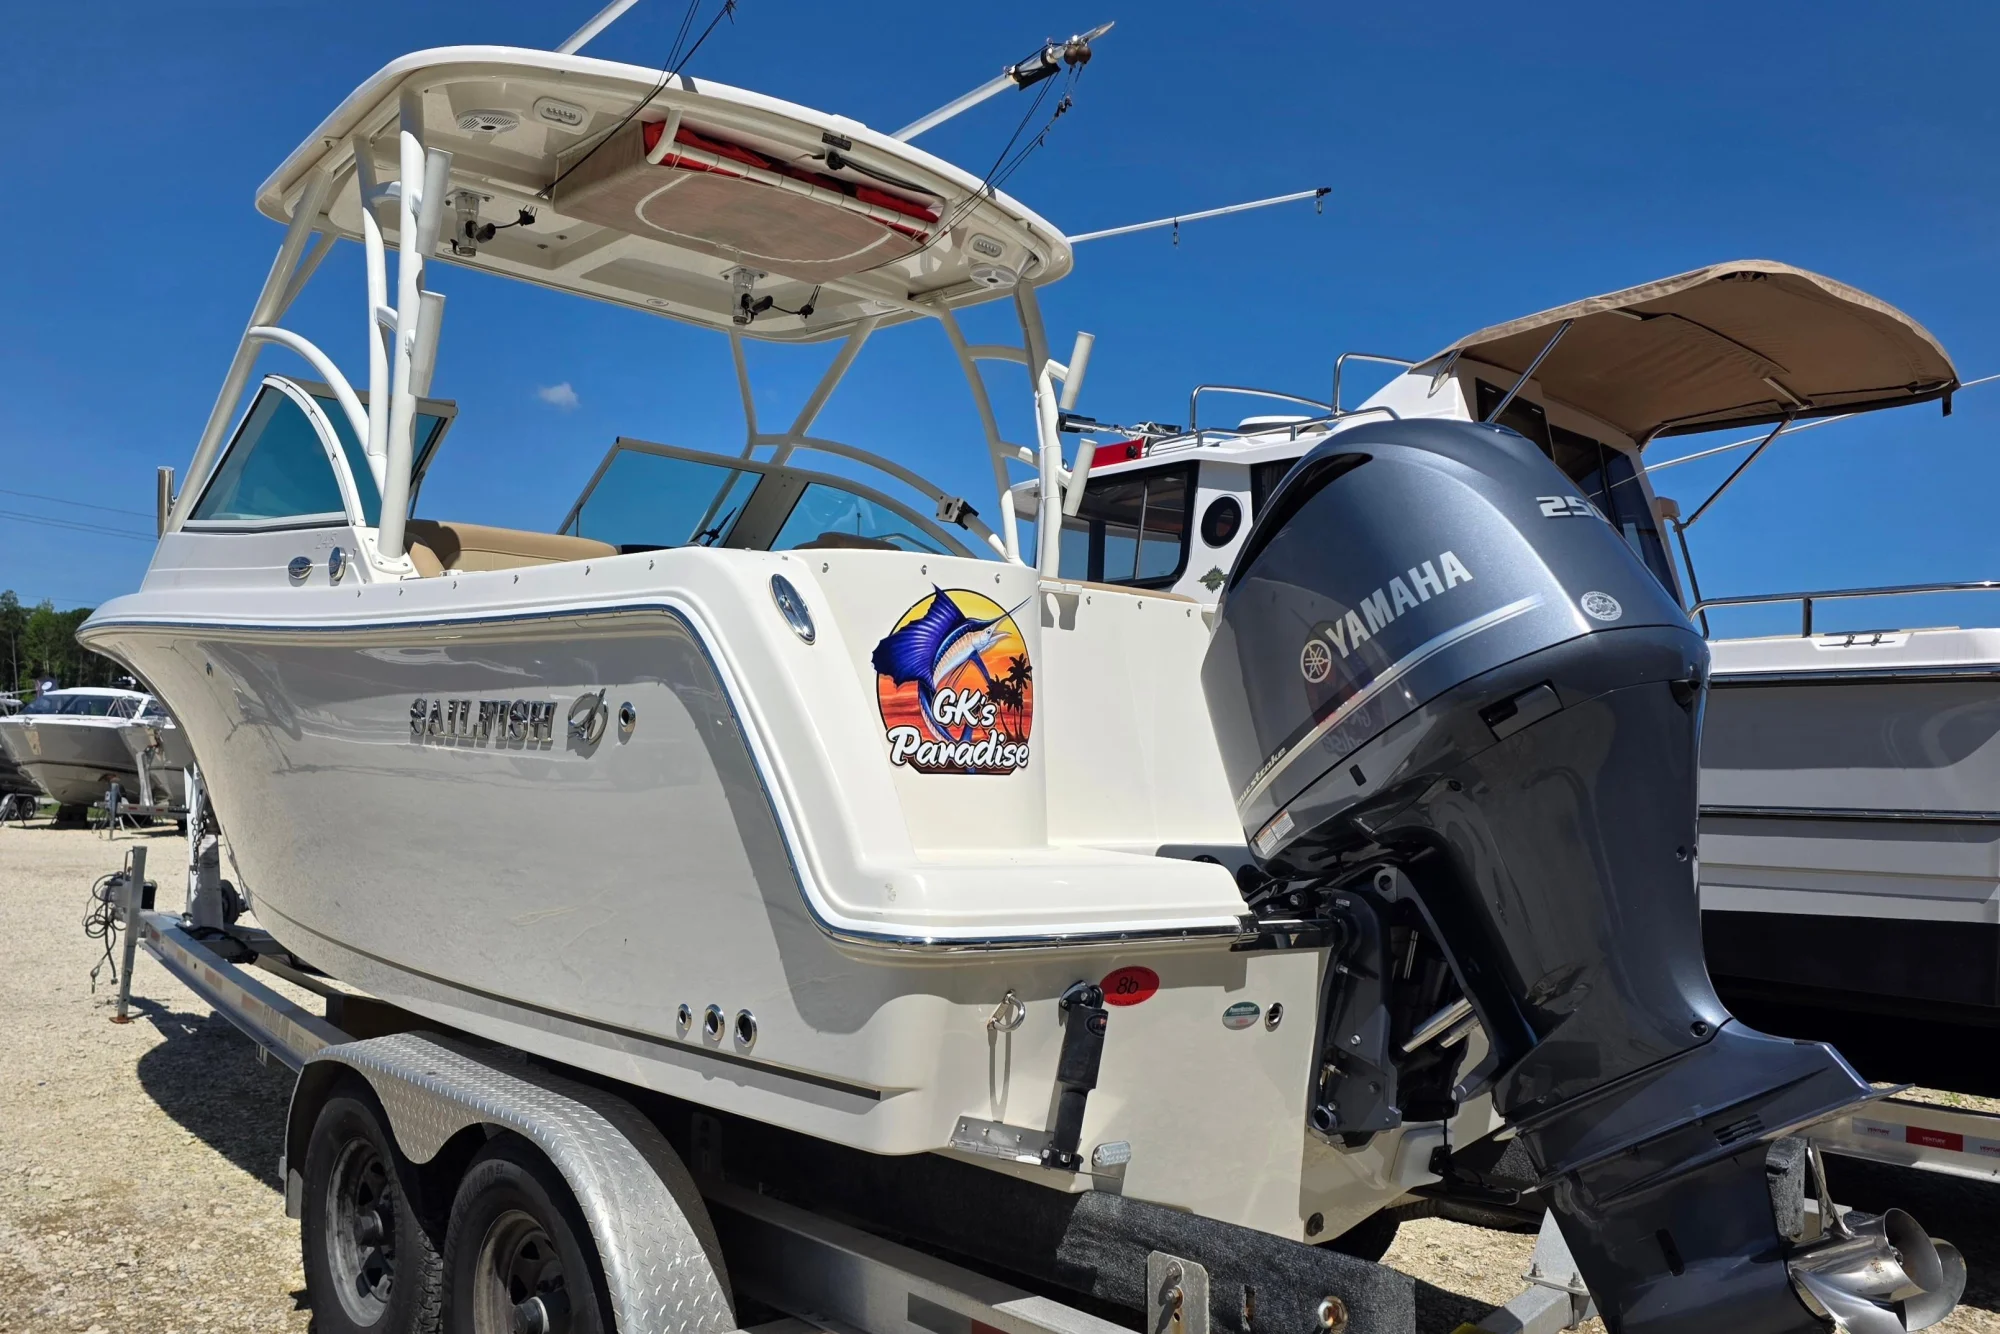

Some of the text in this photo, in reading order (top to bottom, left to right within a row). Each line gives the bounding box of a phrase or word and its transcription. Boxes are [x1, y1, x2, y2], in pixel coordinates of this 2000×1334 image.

[1325, 551, 1474, 659] YAMAHA
[410, 698, 558, 741] SAILFISH
[933, 688, 996, 726] GK's
[887, 726, 1030, 768] Paradise
